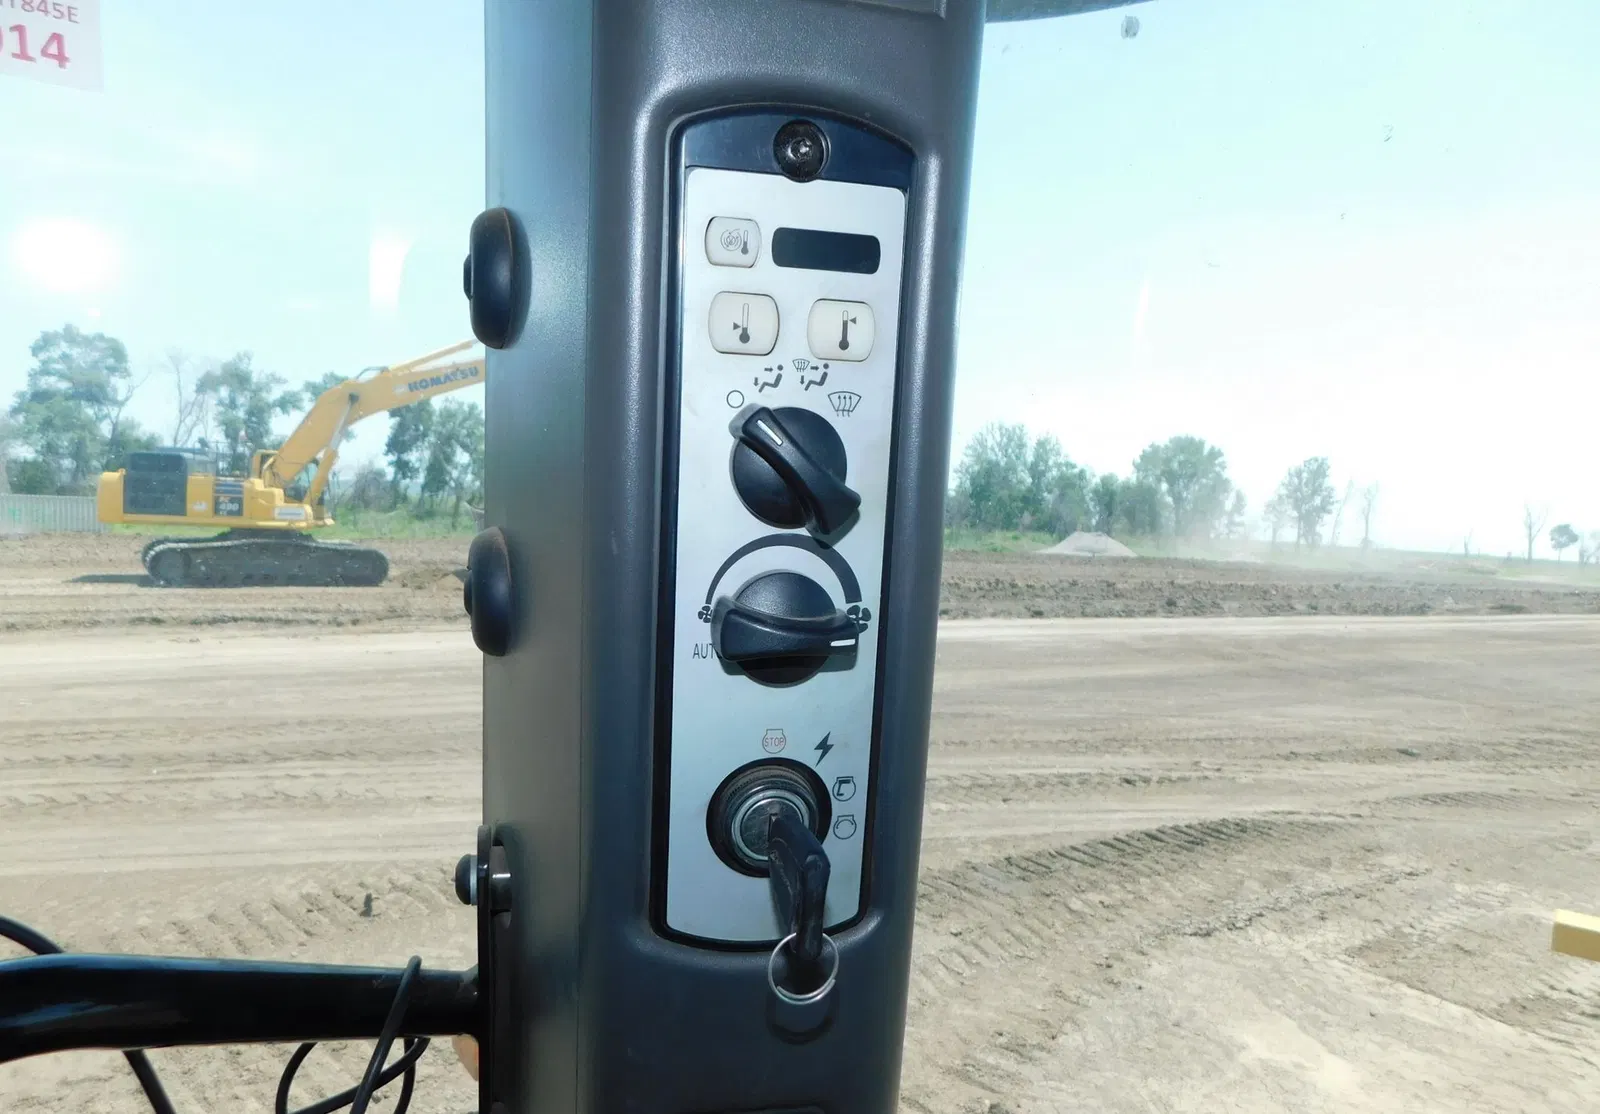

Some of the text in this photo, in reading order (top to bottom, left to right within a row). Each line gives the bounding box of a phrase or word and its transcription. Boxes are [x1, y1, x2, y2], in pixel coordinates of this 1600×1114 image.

[0, 0, 80, 24] 845E
[0, 24, 71, 69] 14
[407, 366, 479, 392] KOMATSU
[692, 643, 715, 659] AUT
[764, 736, 785, 747] STOP
